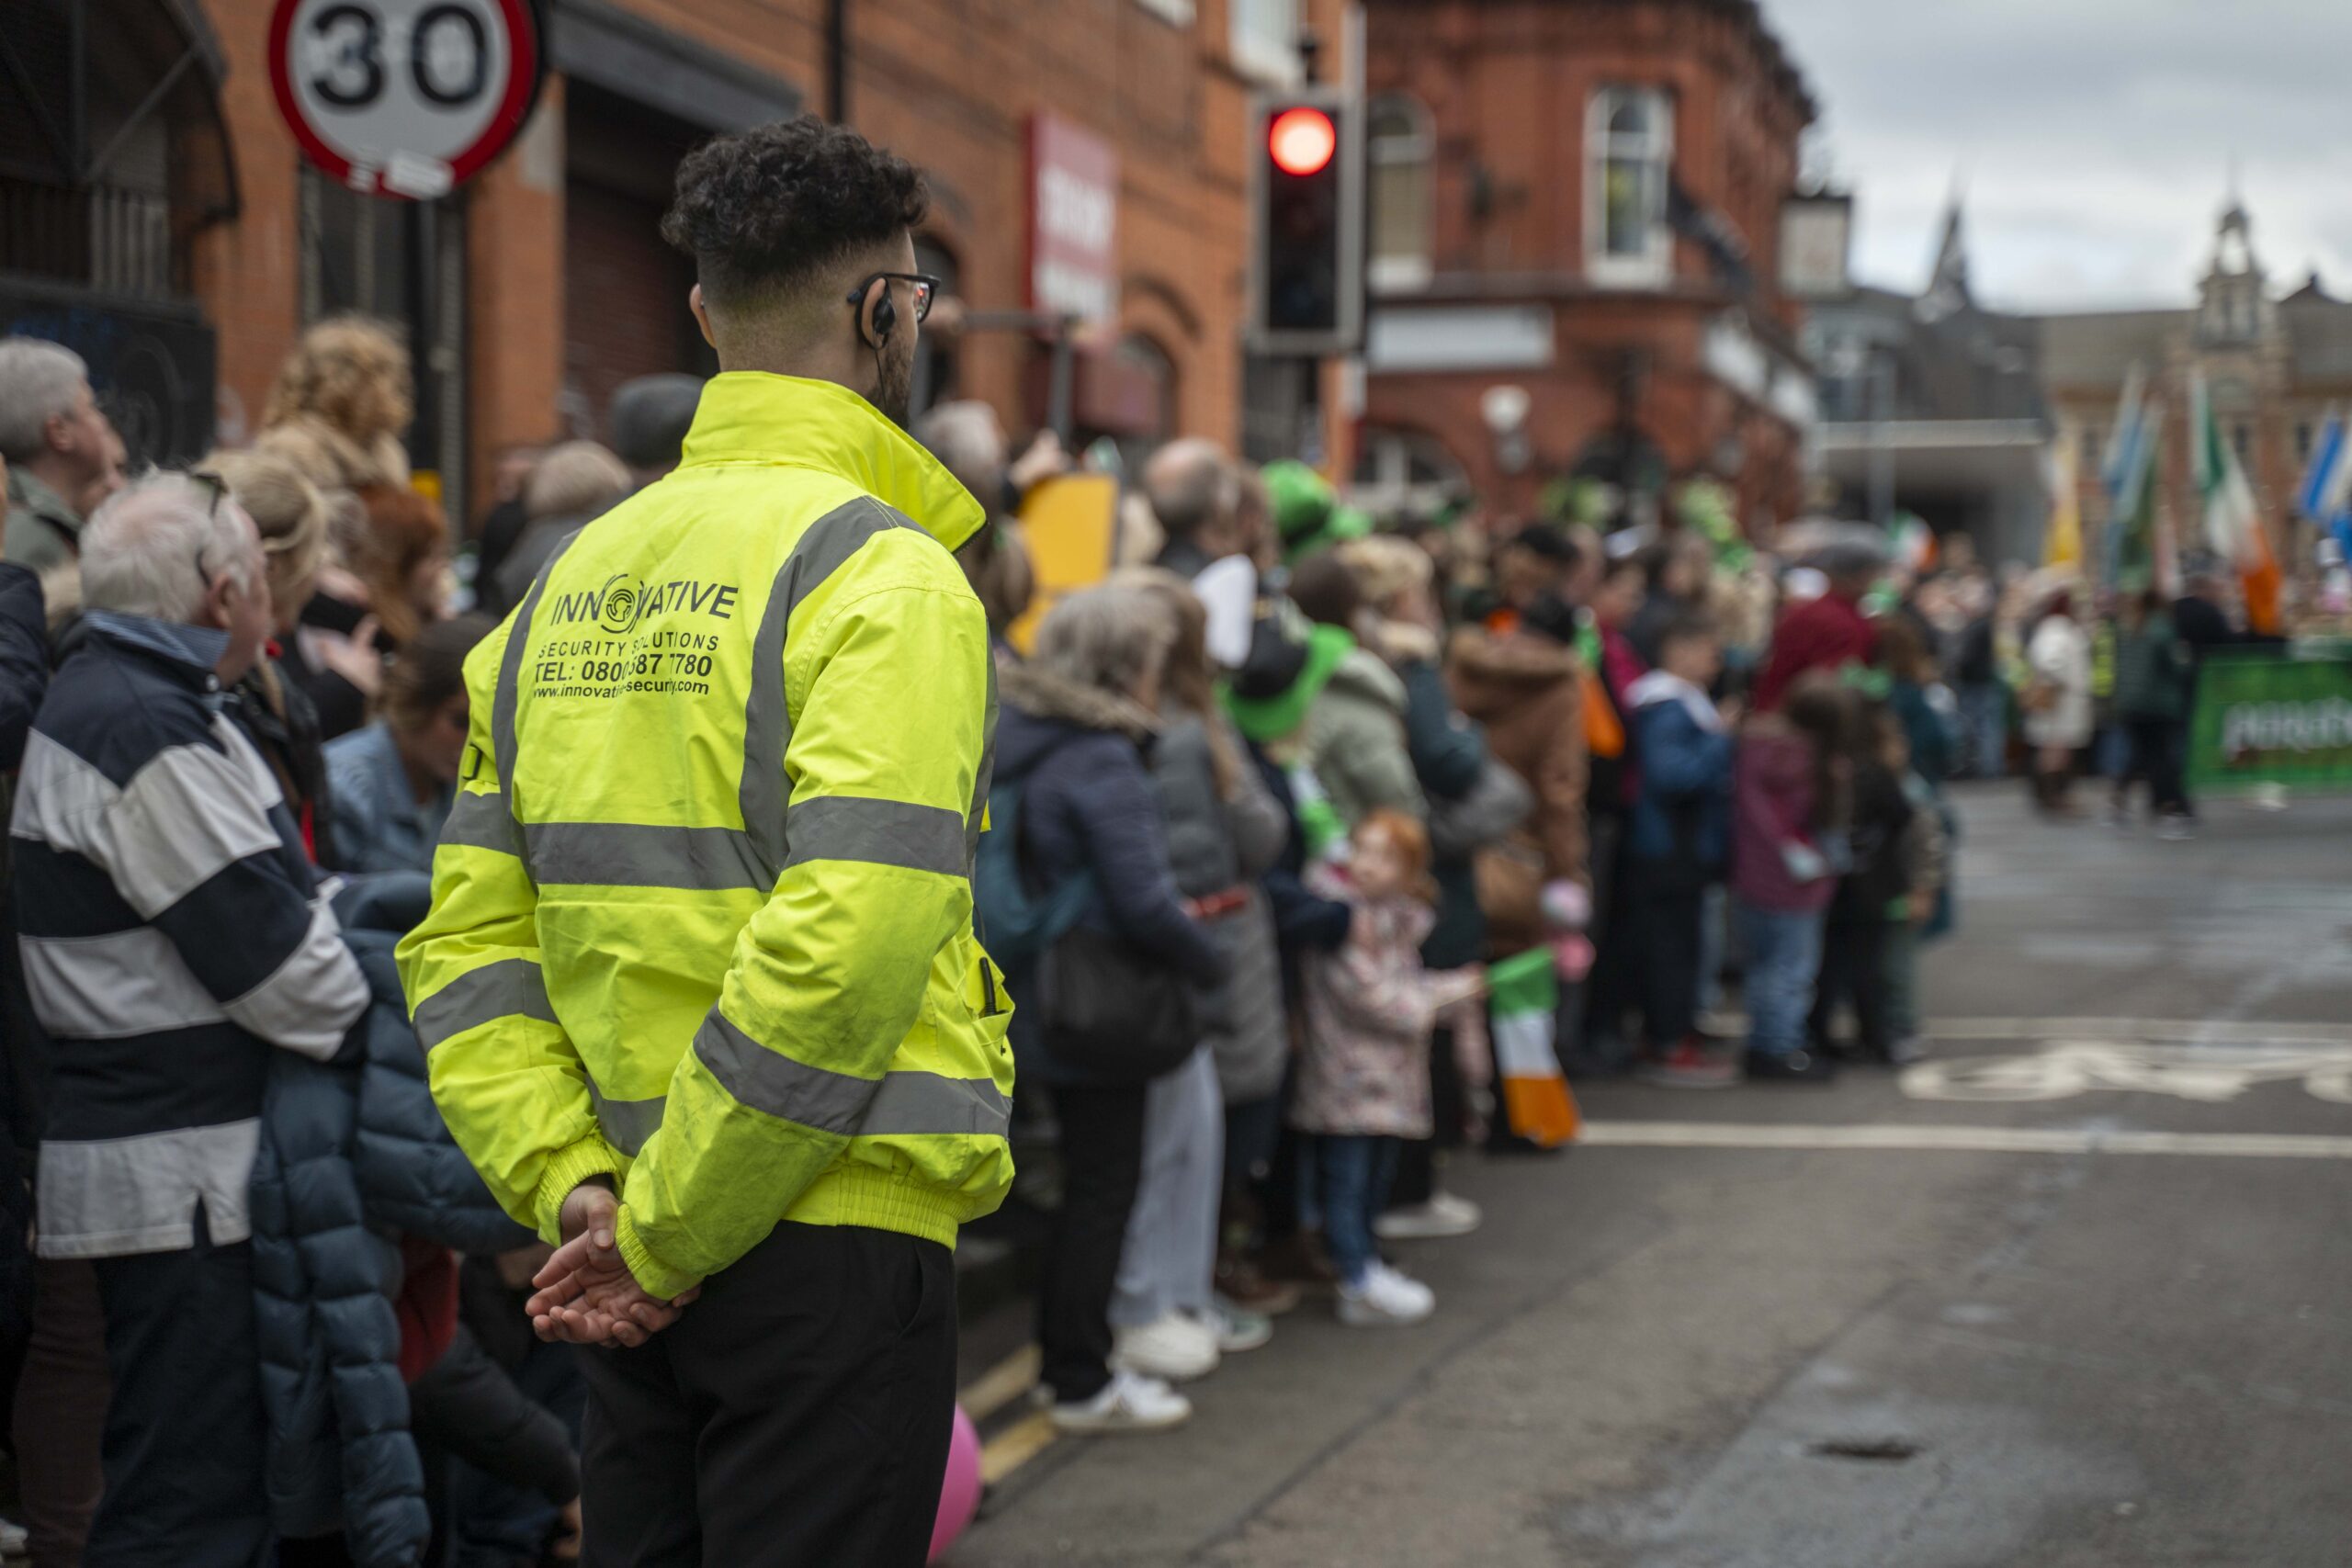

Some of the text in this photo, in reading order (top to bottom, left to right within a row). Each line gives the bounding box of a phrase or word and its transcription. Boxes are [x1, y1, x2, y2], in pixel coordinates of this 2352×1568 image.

[311, 5, 487, 107] 30
[538, 631, 718, 659] SECURITY SOLUTIONS
[536, 661, 575, 682] TEL:
